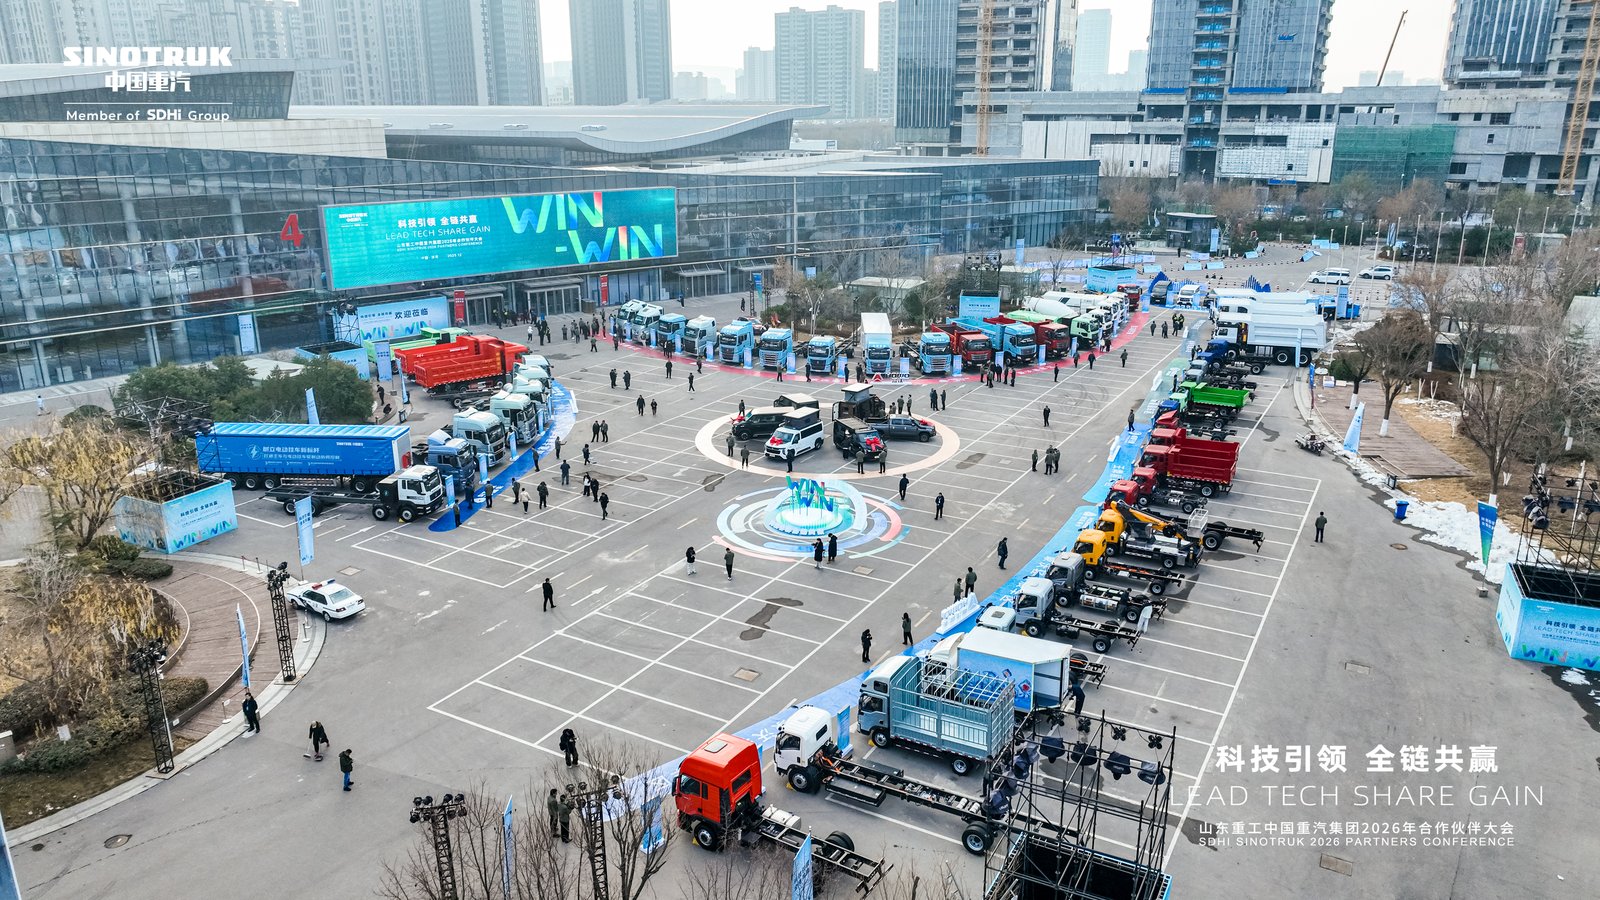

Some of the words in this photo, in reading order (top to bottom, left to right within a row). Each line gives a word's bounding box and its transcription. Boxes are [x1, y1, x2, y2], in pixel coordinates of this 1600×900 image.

[501, 191, 604, 234] WIN
[280, 213, 304, 247] 4
[385, 231, 409, 241] LEAD
[413, 229, 435, 239] TECH
[437, 227, 467, 237] SHARE
[469, 225, 491, 235] GAIN
[394, 307, 429, 319] 欢迎莅临
